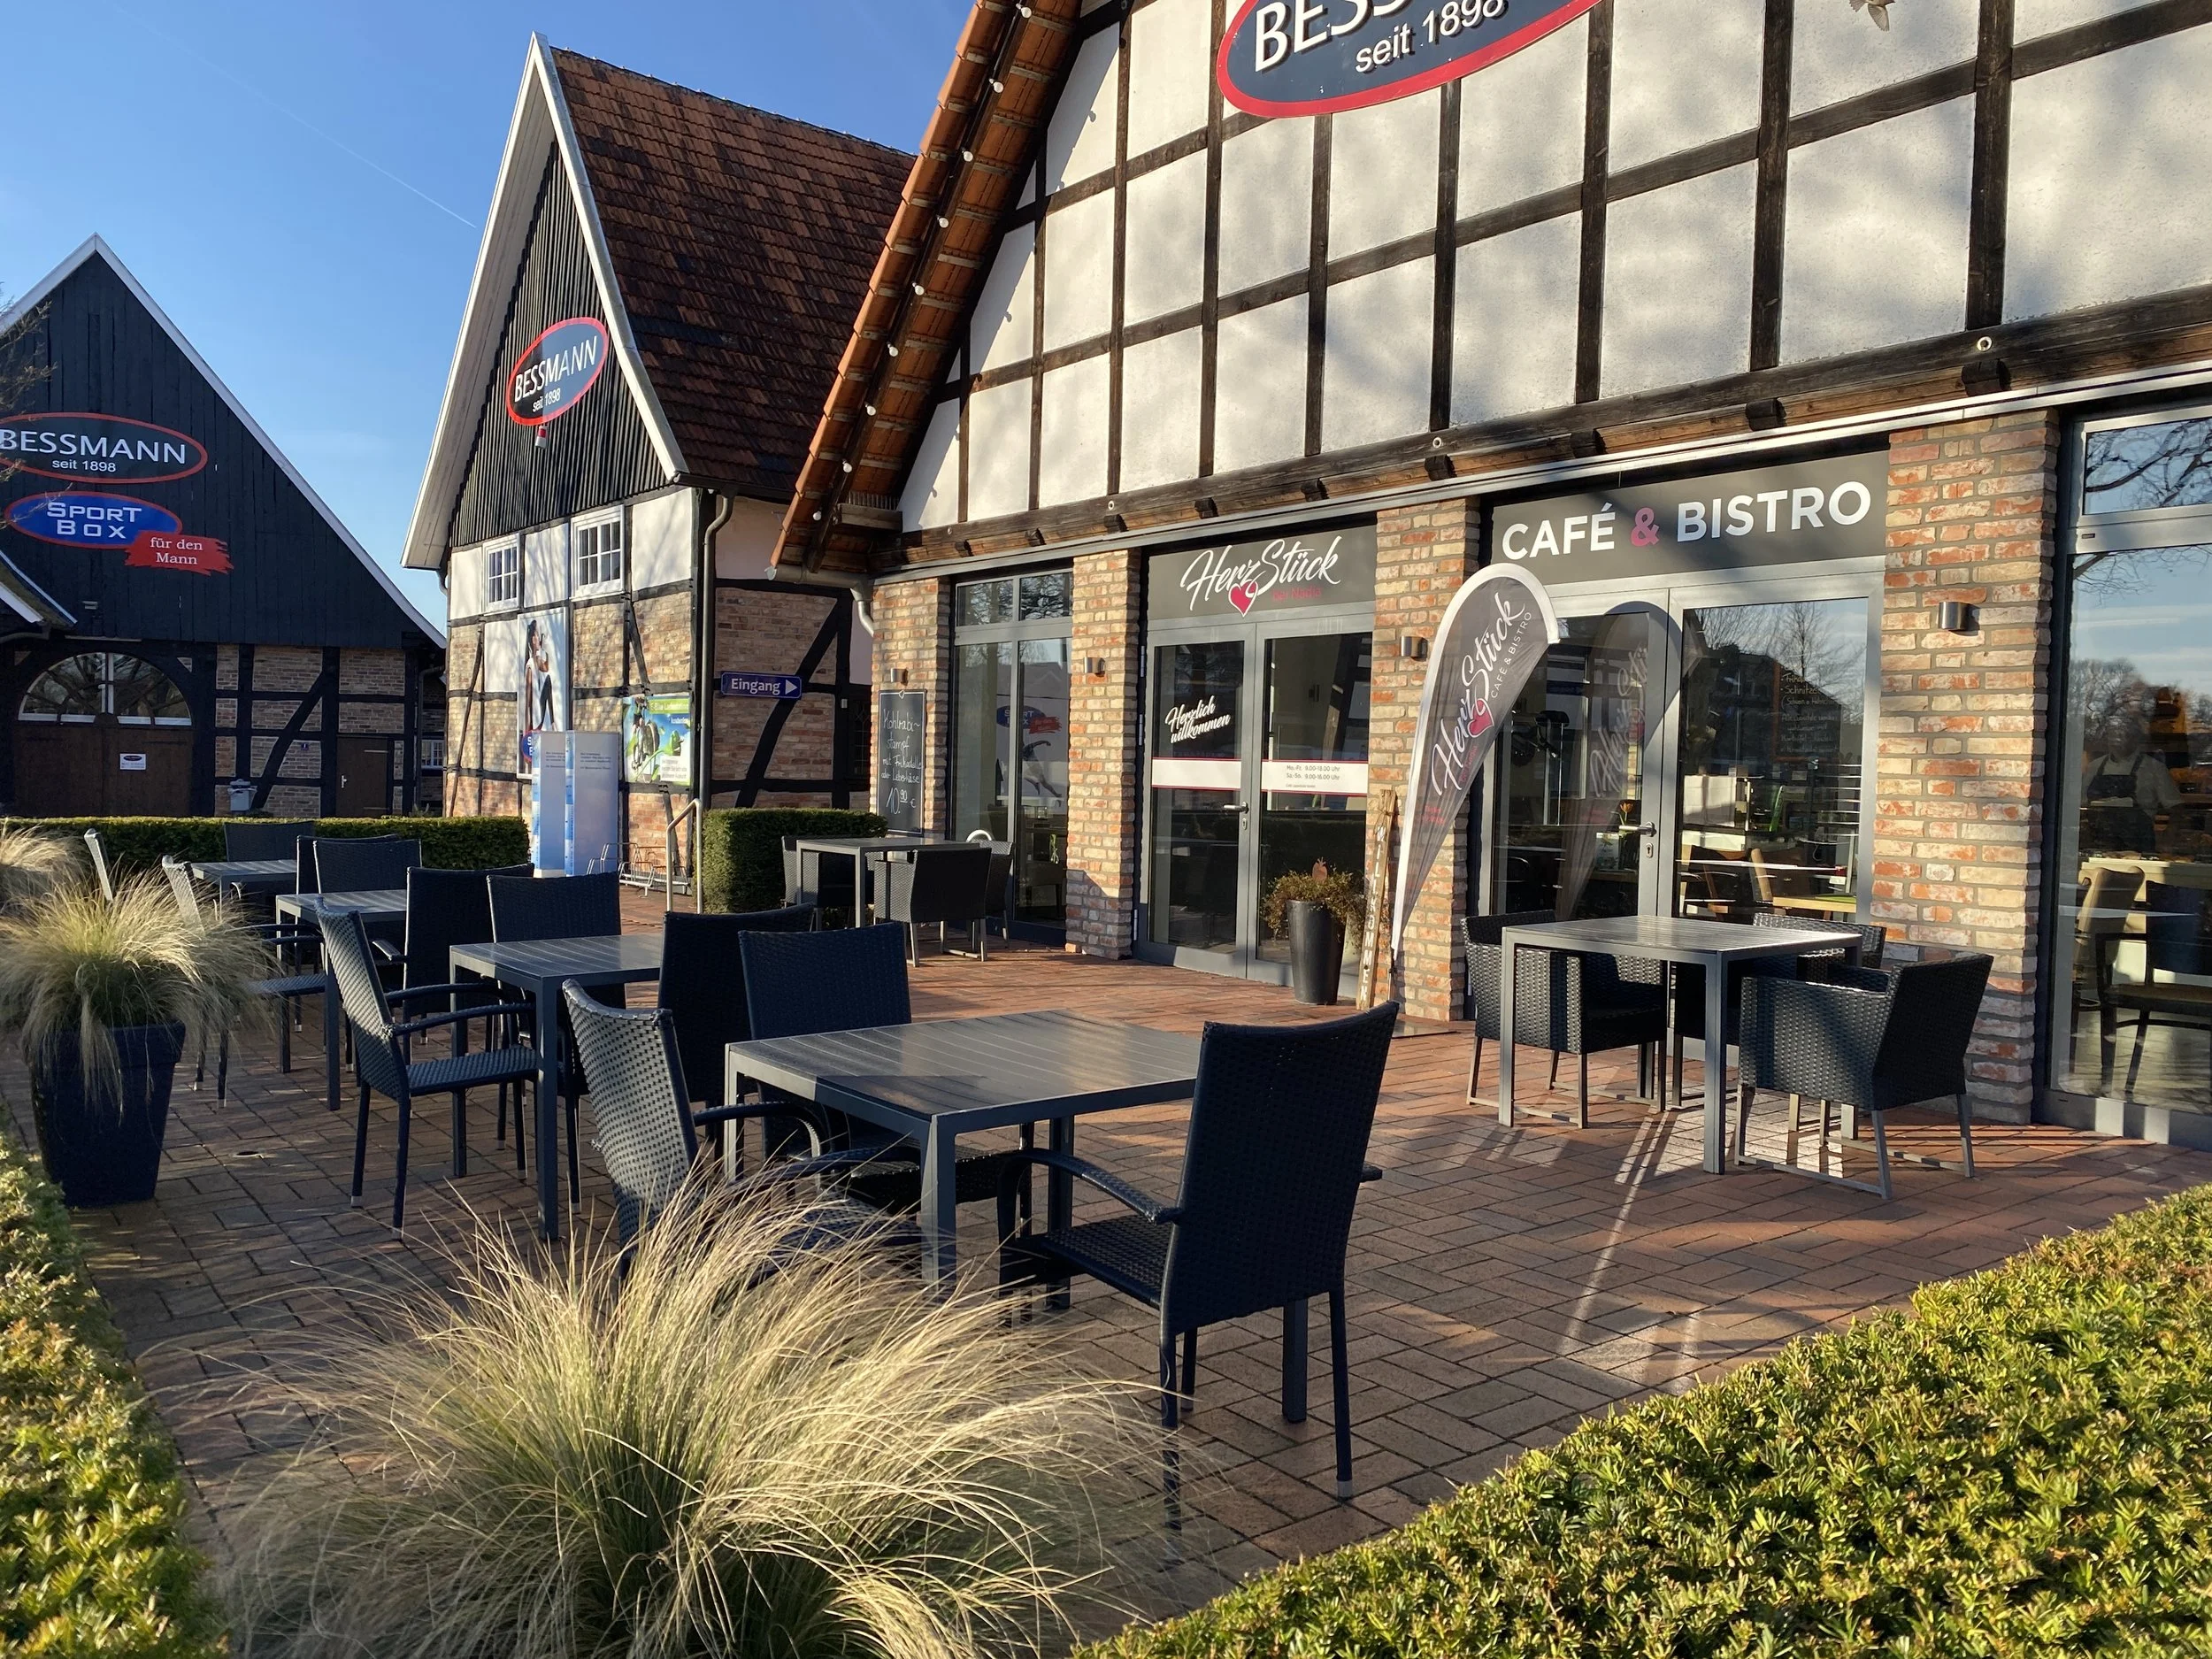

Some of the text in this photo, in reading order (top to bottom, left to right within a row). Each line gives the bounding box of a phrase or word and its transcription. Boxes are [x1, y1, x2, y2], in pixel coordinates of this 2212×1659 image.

[1256, 0, 1409, 72] BES
[1356, 0, 1502, 73] seit 1898
[514, 335, 597, 403] BESSMANN
[533, 388, 562, 412] seit 1898
[0, 429, 185, 464] BESSMANN
[52, 458, 116, 472] seit 1898
[47, 502, 142, 523] SPORT
[1502, 481, 1870, 560] CAFÉ & BISTRO
[57, 519, 126, 539] BOX
[150, 537, 203, 550] für den
[156, 552, 197, 565] Mann
[1509, 612, 1532, 655] BISTRO
[731, 678, 781, 695] Eingang
[1164, 695, 1216, 733] Herzlich
[1171, 714, 1231, 743] willkommen
[1360, 825, 1386, 1001] WILLKOMMEN
